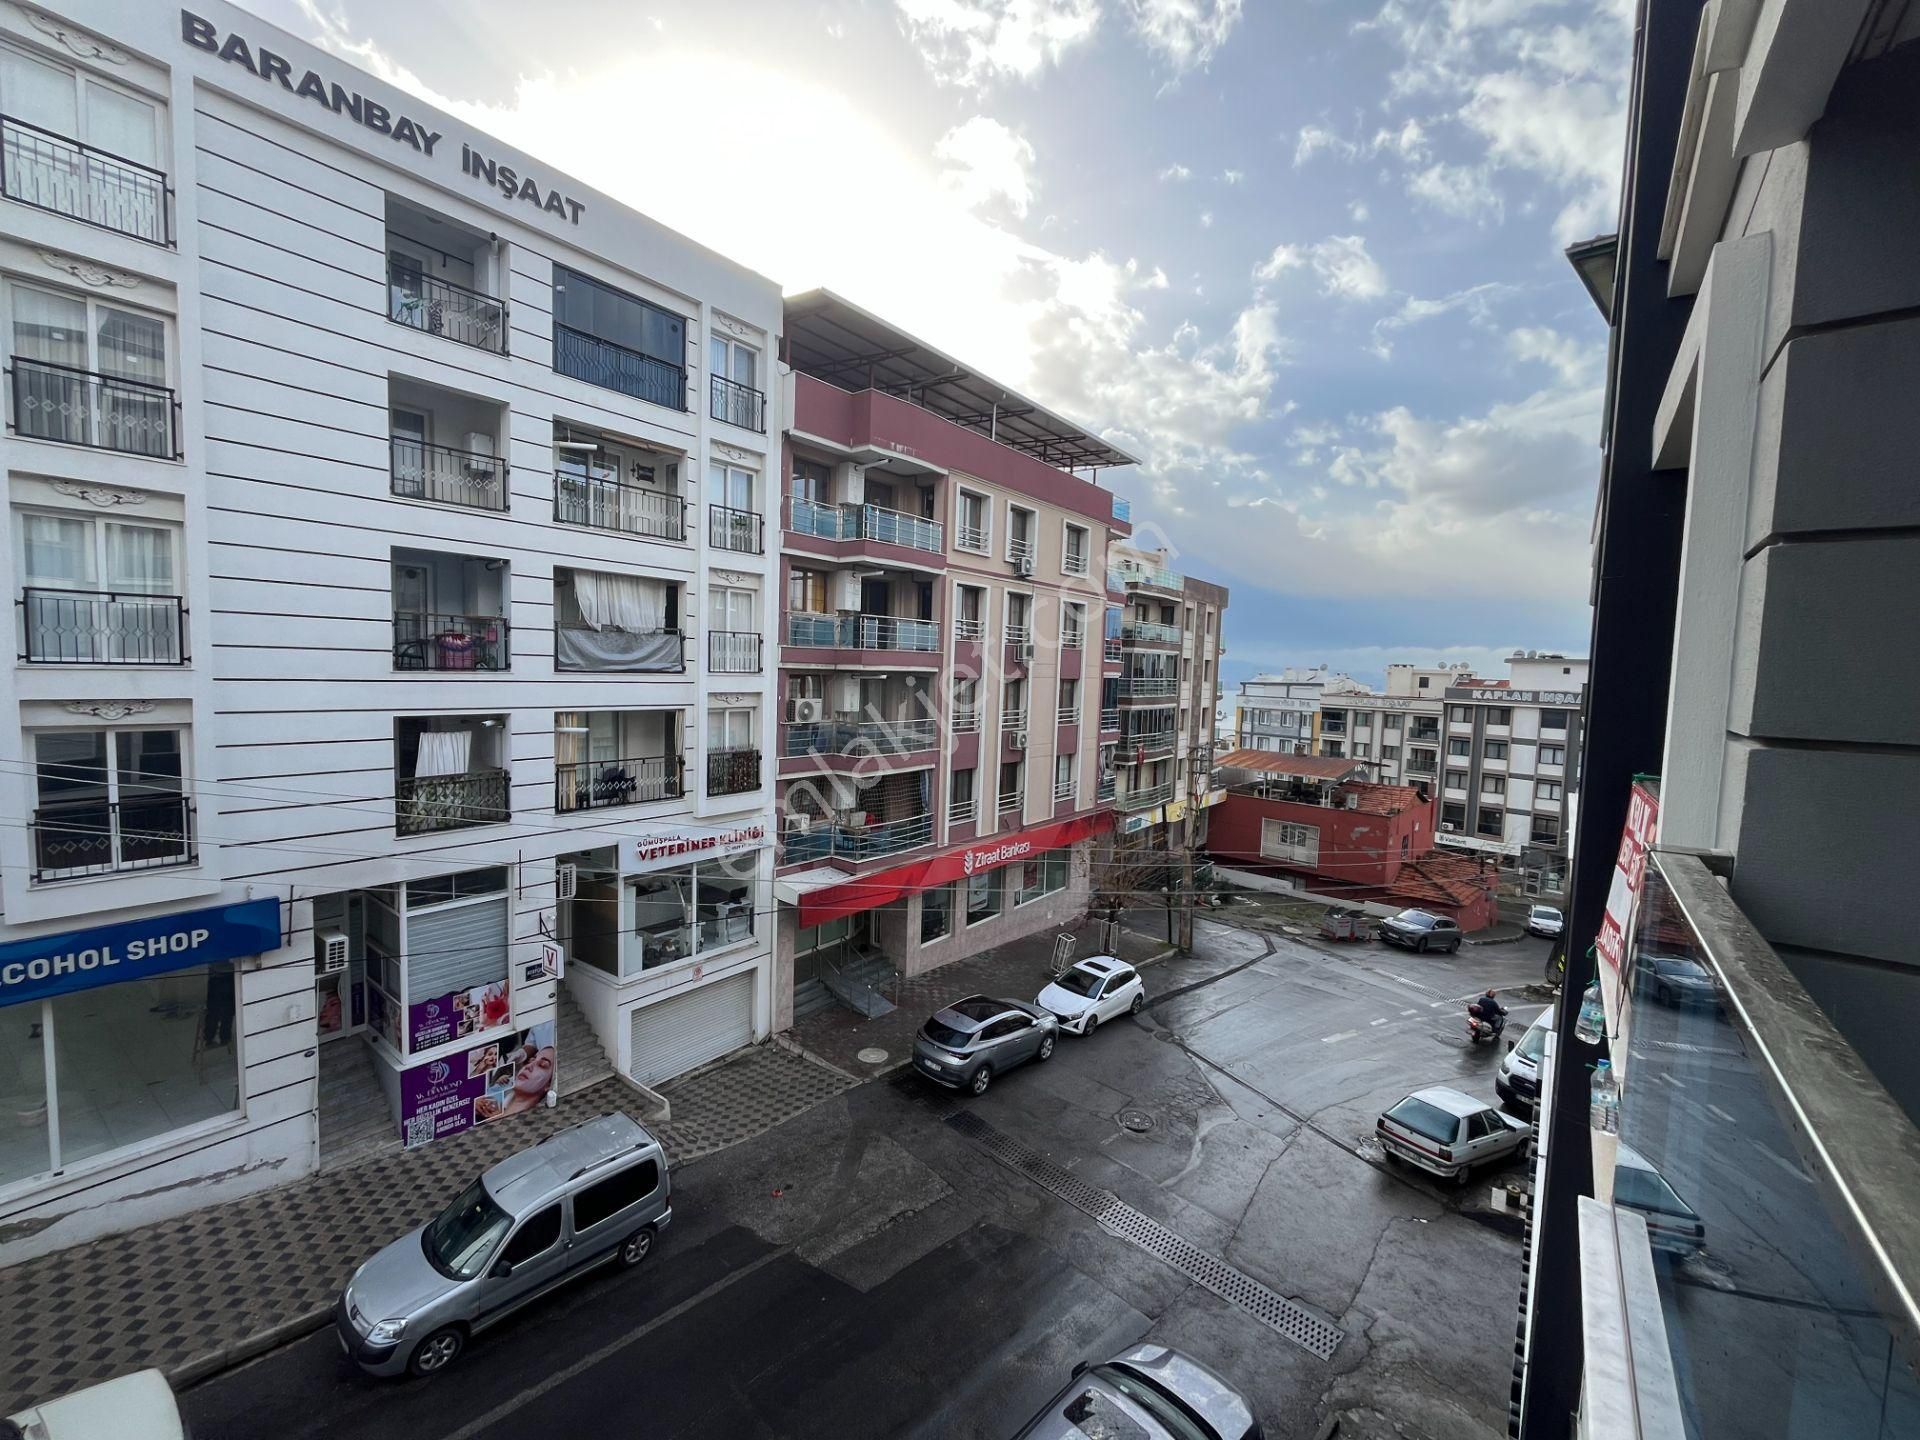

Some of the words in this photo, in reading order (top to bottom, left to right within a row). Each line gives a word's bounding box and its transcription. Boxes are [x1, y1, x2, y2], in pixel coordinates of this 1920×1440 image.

[181, 8, 442, 157] BARANBAY
[461, 143, 586, 225] İNŞAAT
[1472, 690, 1532, 702] KAPLAN
[637, 834, 681, 848] GÜMÜŞPALA
[638, 838, 716, 861] VETERİNER
[719, 824, 764, 845] KLİNİĞİ
[975, 848, 1000, 868] Ziraat
[1001, 841, 1030, 860] Bankası
[0, 947, 120, 987] COHOL
[127, 929, 209, 960] SHOP
